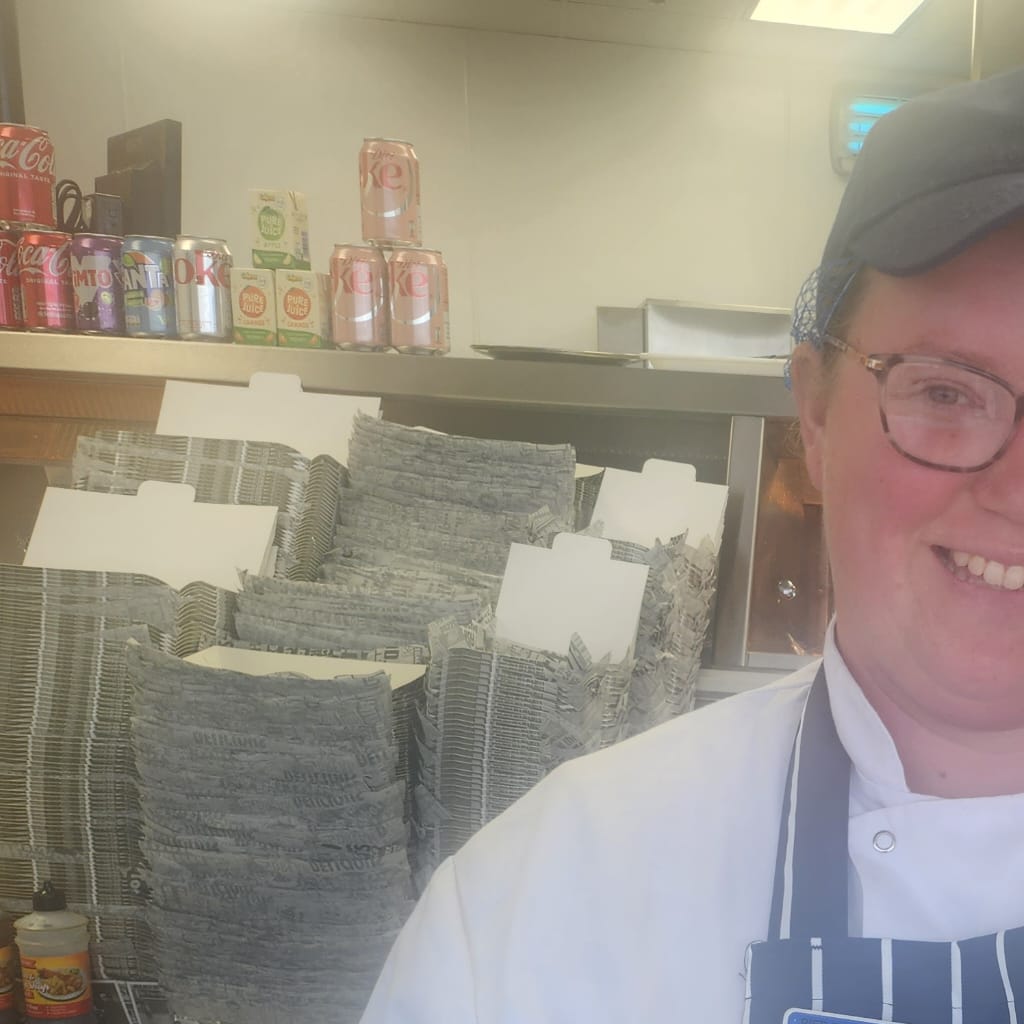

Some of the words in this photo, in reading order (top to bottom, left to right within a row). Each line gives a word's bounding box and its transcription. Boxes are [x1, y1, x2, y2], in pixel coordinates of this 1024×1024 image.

[260, 215, 282, 226] PURE
[260, 225, 282, 236] JUICE
[123, 264, 169, 291] ANTA
[242, 293, 265, 305] PURE
[286, 295, 309, 307] PURE
[242, 302, 264, 314] JUICE
[286, 304, 309, 316] JUICE
